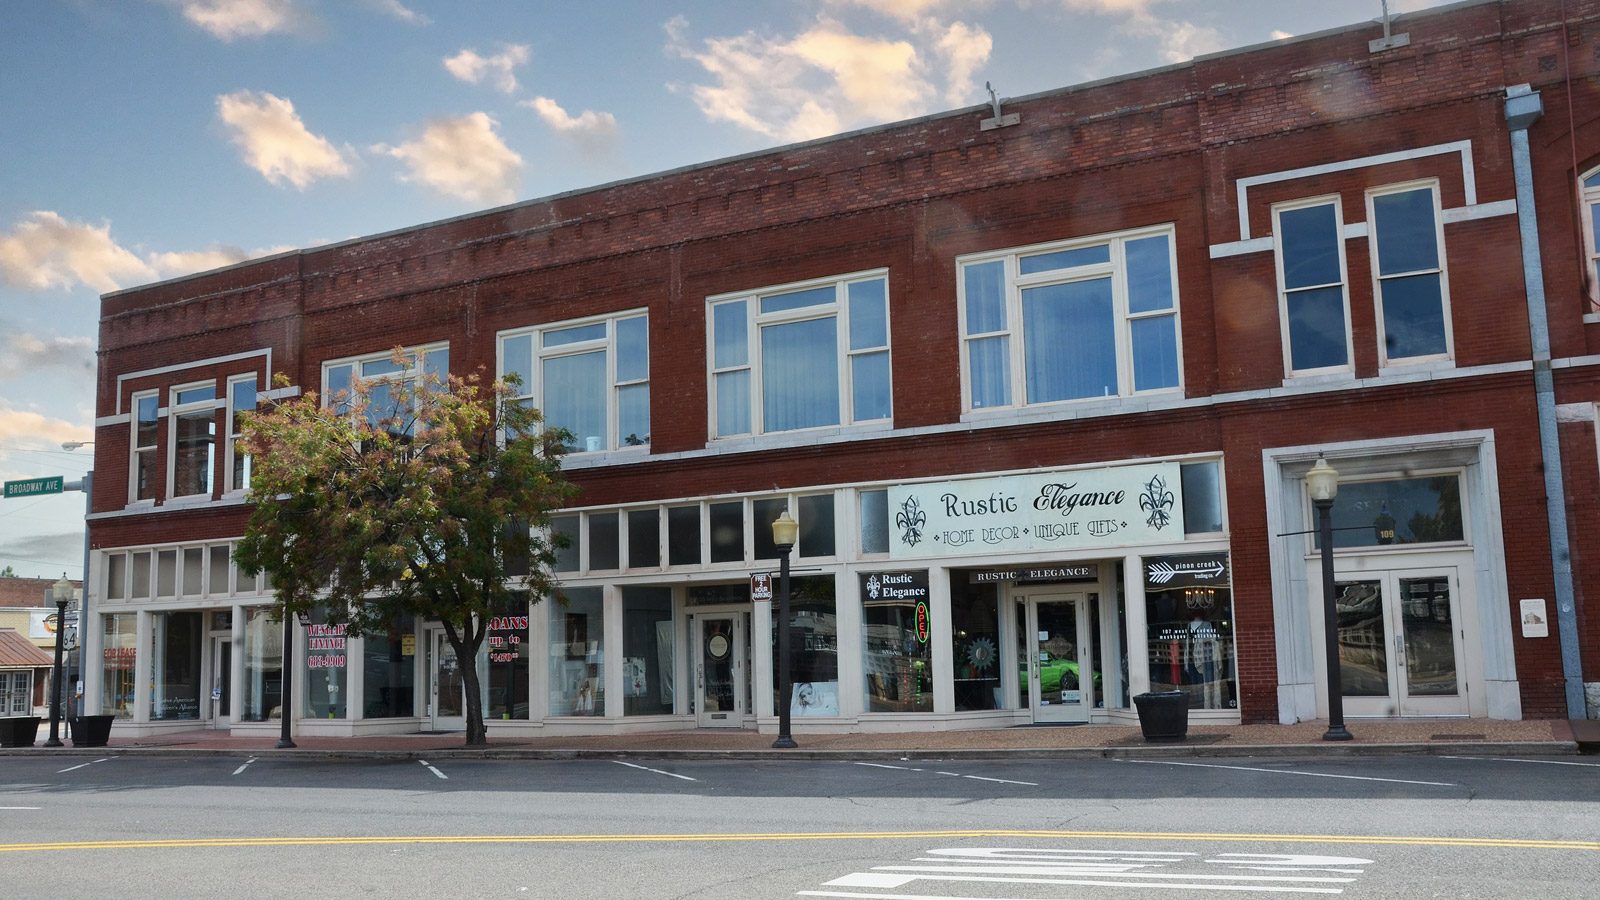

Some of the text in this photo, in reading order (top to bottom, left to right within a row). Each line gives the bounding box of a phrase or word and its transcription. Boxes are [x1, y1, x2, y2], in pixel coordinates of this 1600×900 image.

[9, 480, 58, 494] BROADWAY AVE
[940, 481, 1126, 517] Rustic Elegance
[943, 519, 1119, 546] HOME DECOR UNIQUE GIFTS
[1380, 530, 1394, 539] 109
[1196, 560, 1216, 568] creek
[882, 573, 913, 584] Rustic
[977, 567, 1089, 581] RUSTIC ELEGANCE
[882, 587, 926, 599] Elegance
[918, 605, 927, 639] OPEN
[63, 633, 76, 646] 64
[309, 637, 346, 650] FINANCE
[488, 633, 521, 648] up to
